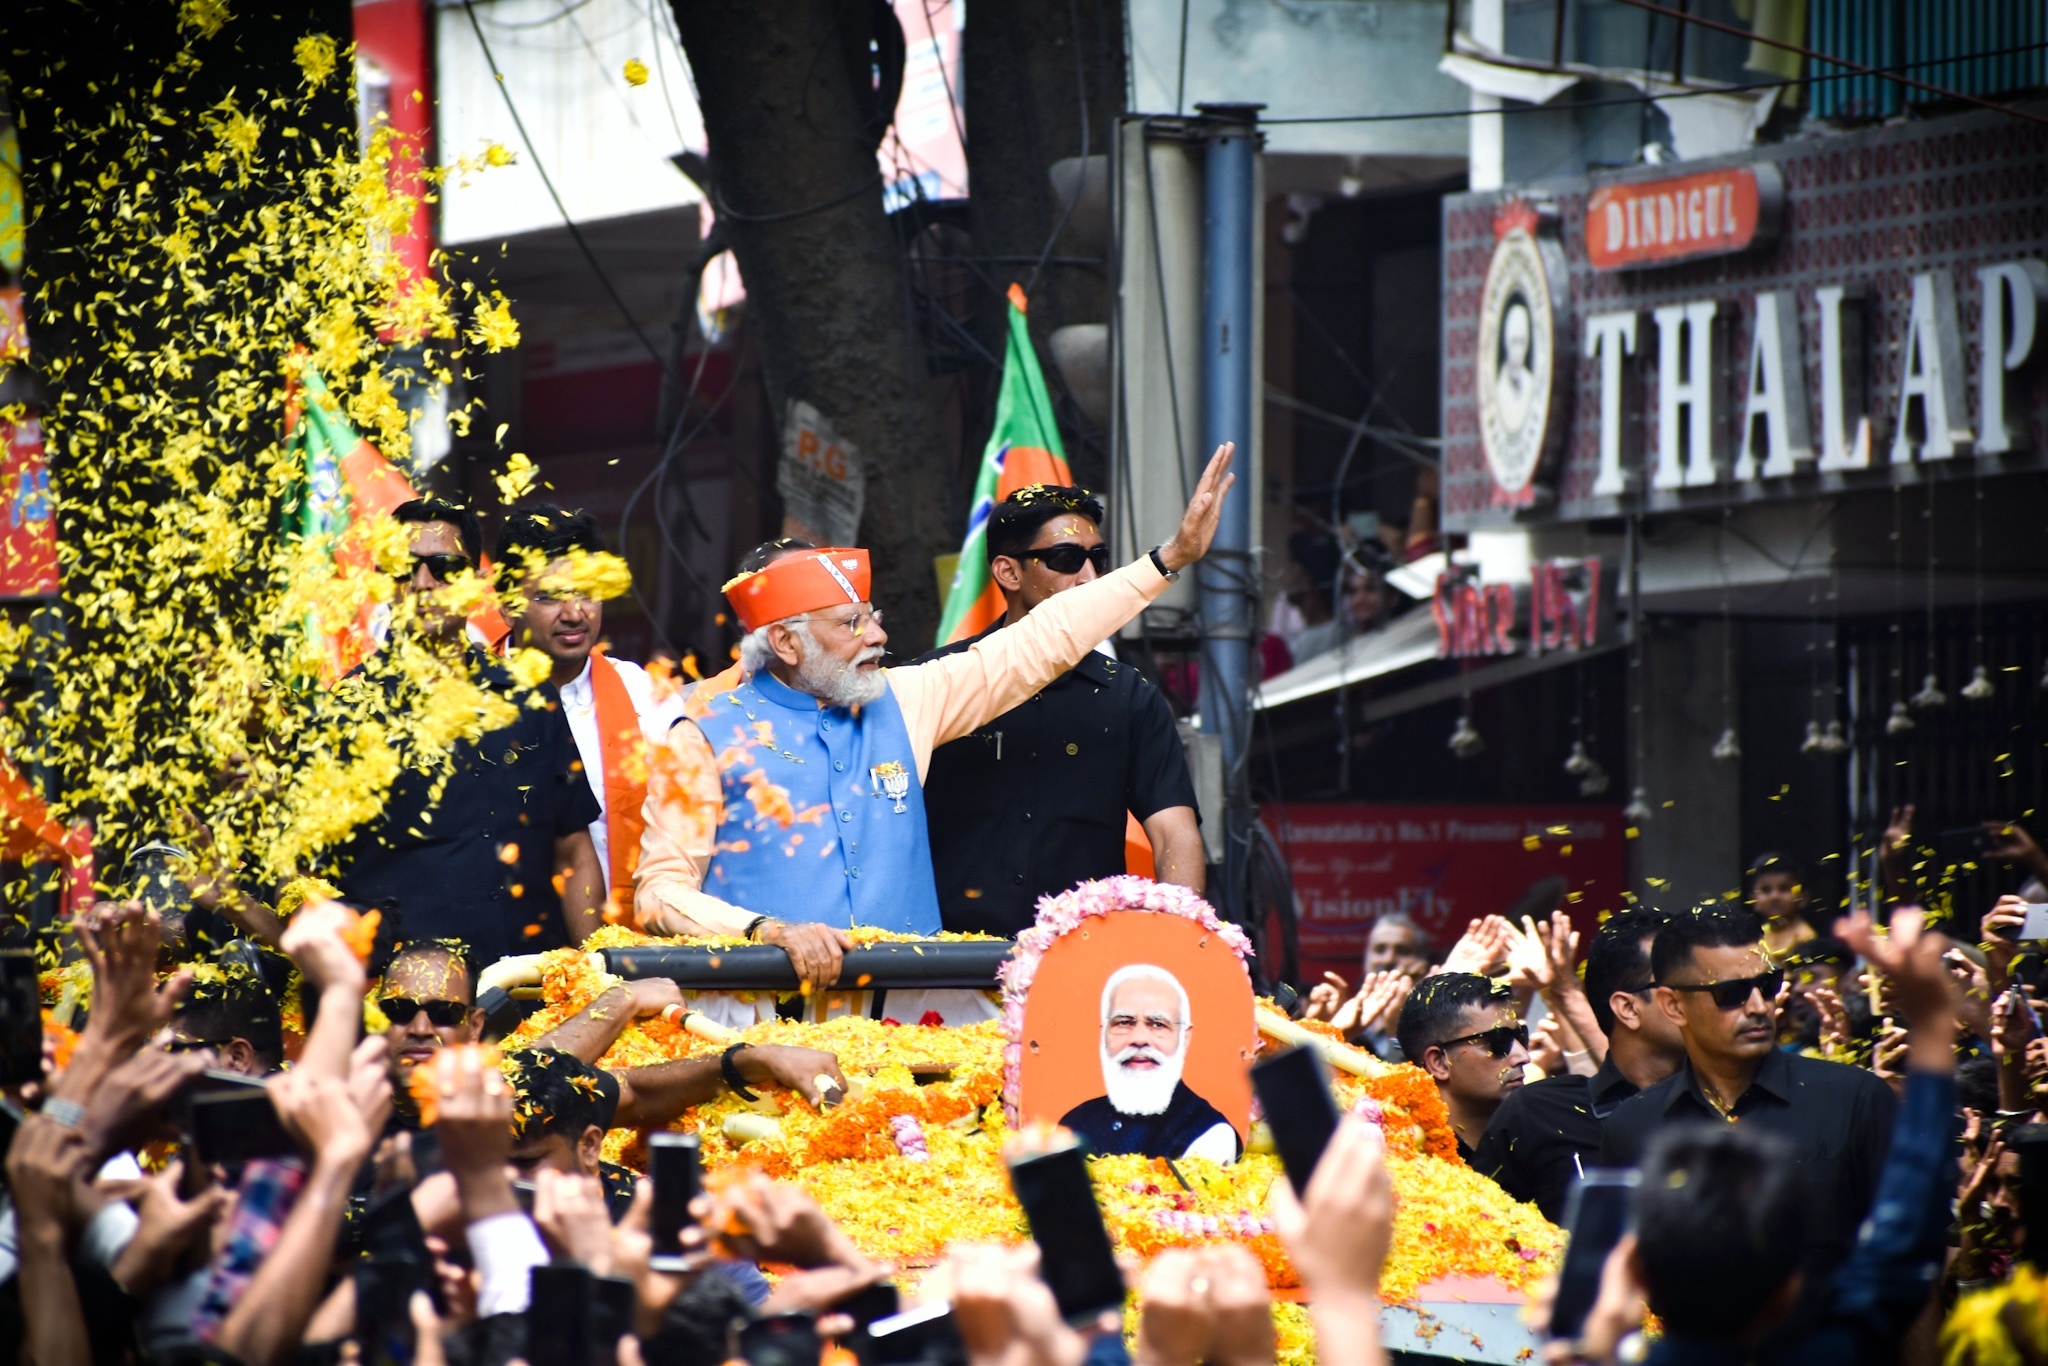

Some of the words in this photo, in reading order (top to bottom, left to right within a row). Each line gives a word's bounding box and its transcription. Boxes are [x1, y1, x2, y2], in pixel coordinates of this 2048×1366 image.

[1605, 182, 1737, 253] DINDIGUL
[1584, 261, 2038, 495] THALAP
[796, 427, 848, 481] P.G
